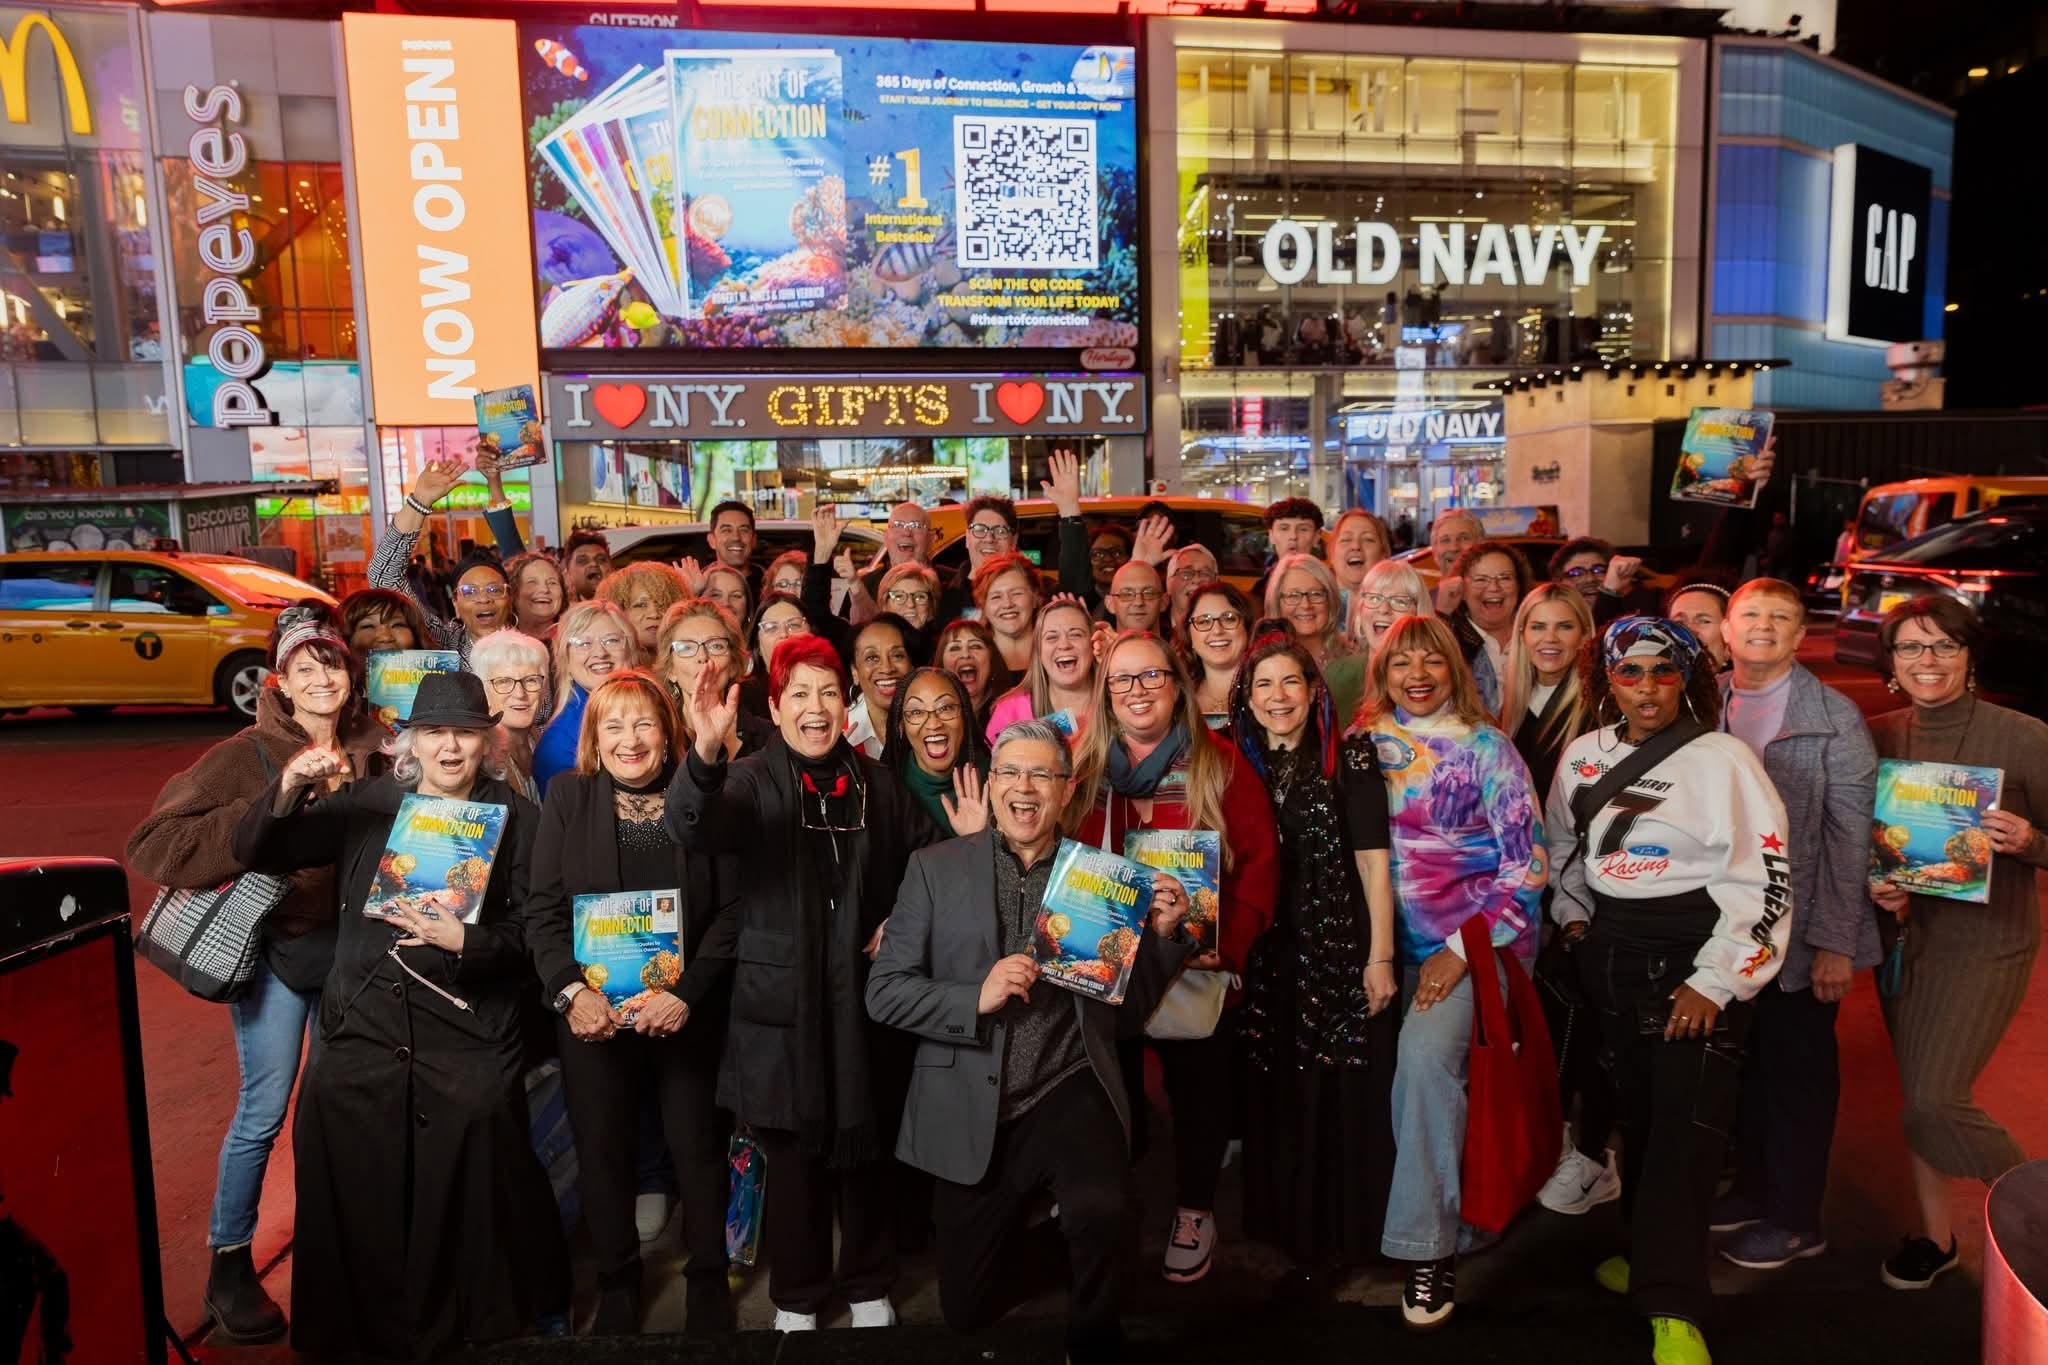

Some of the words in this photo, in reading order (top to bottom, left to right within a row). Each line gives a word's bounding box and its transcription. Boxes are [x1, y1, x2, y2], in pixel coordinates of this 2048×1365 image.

[787, 69, 809, 98] OF
[876, 75, 900, 89] 365
[902, 76, 931, 91] Days
[933, 76, 948, 90] of
[949, 78, 1020, 95] Connection,
[1022, 81, 1065, 94] Growth
[694, 103, 827, 140] CONNECTION
[864, 212, 943, 226] International
[876, 230, 935, 243] Bestseller
[1262, 219, 1402, 285] OLD
[1418, 222, 1606, 286] NAVY
[1864, 203, 1917, 294] GAP
[969, 278, 1003, 290] SCAN
[1004, 278, 1028, 290] THE
[1030, 279, 1048, 292] QR
[1050, 279, 1083, 290] CODE
[937, 295, 1012, 308] TRANSFORM
[1013, 296, 1048, 308] YOUR
[1049, 296, 1075, 308] LIFE
[1076, 296, 1120, 308] TODAY!
[416, 243, 478, 401] NOW
[970, 313, 1089, 326] #theartofconnection
[564, 384, 593, 428] I
[767, 384, 950, 427] GIFTS
[970, 382, 995, 424] I
[1425, 412, 1500, 443] NAVY
[51, 508, 75, 520] YOU
[77, 508, 117, 519] KNOW
[187, 504, 249, 530] DISCOVER
[468, 808, 482, 821] OF
[411, 814, 486, 839] CONNECTION
[1184, 835, 1196, 850] OF
[1122, 867, 1136, 884] OF
[1597, 849, 1670, 880] Racing
[1067, 867, 1139, 907] CONNECTION
[640, 896, 652, 913] OF
[589, 914, 653, 937] CONNECTIO
